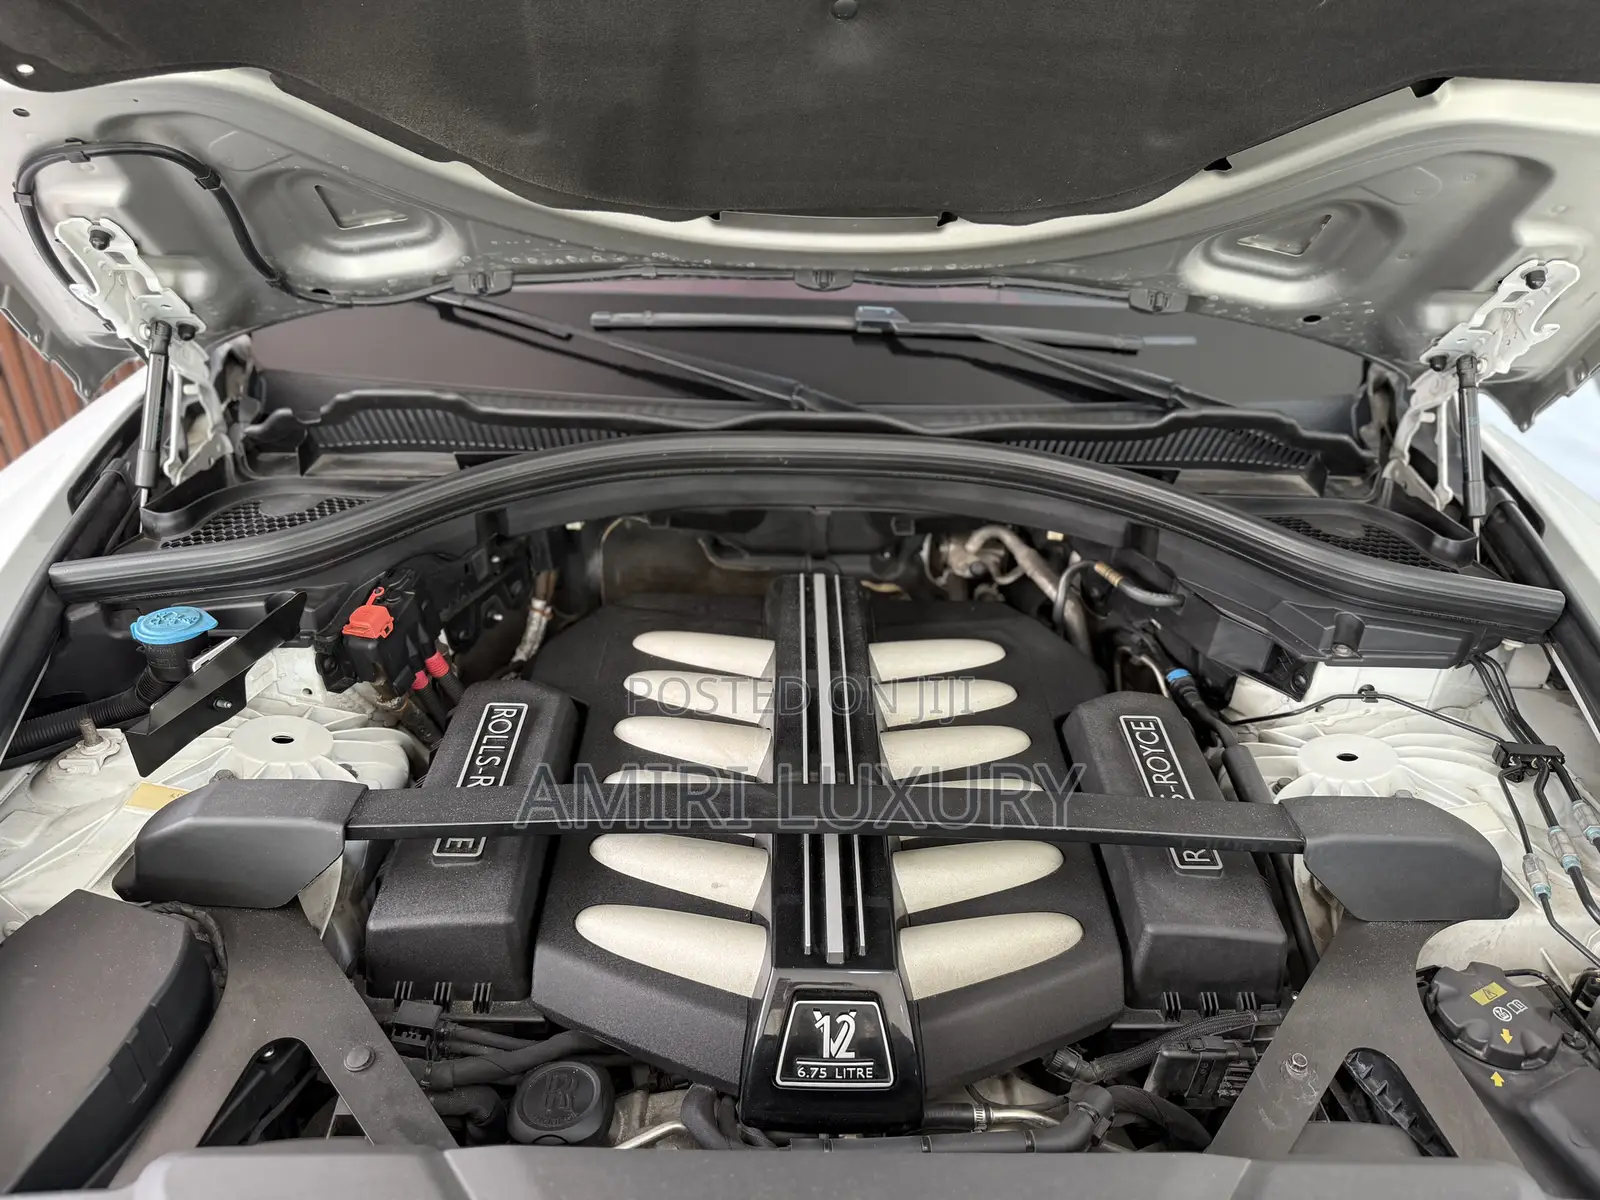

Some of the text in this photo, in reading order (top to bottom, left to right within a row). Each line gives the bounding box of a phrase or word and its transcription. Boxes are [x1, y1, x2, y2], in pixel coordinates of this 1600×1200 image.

[445, 708, 518, 849] ROLLS-RE
[797, 1067, 873, 1079] 6.75 LITRE
